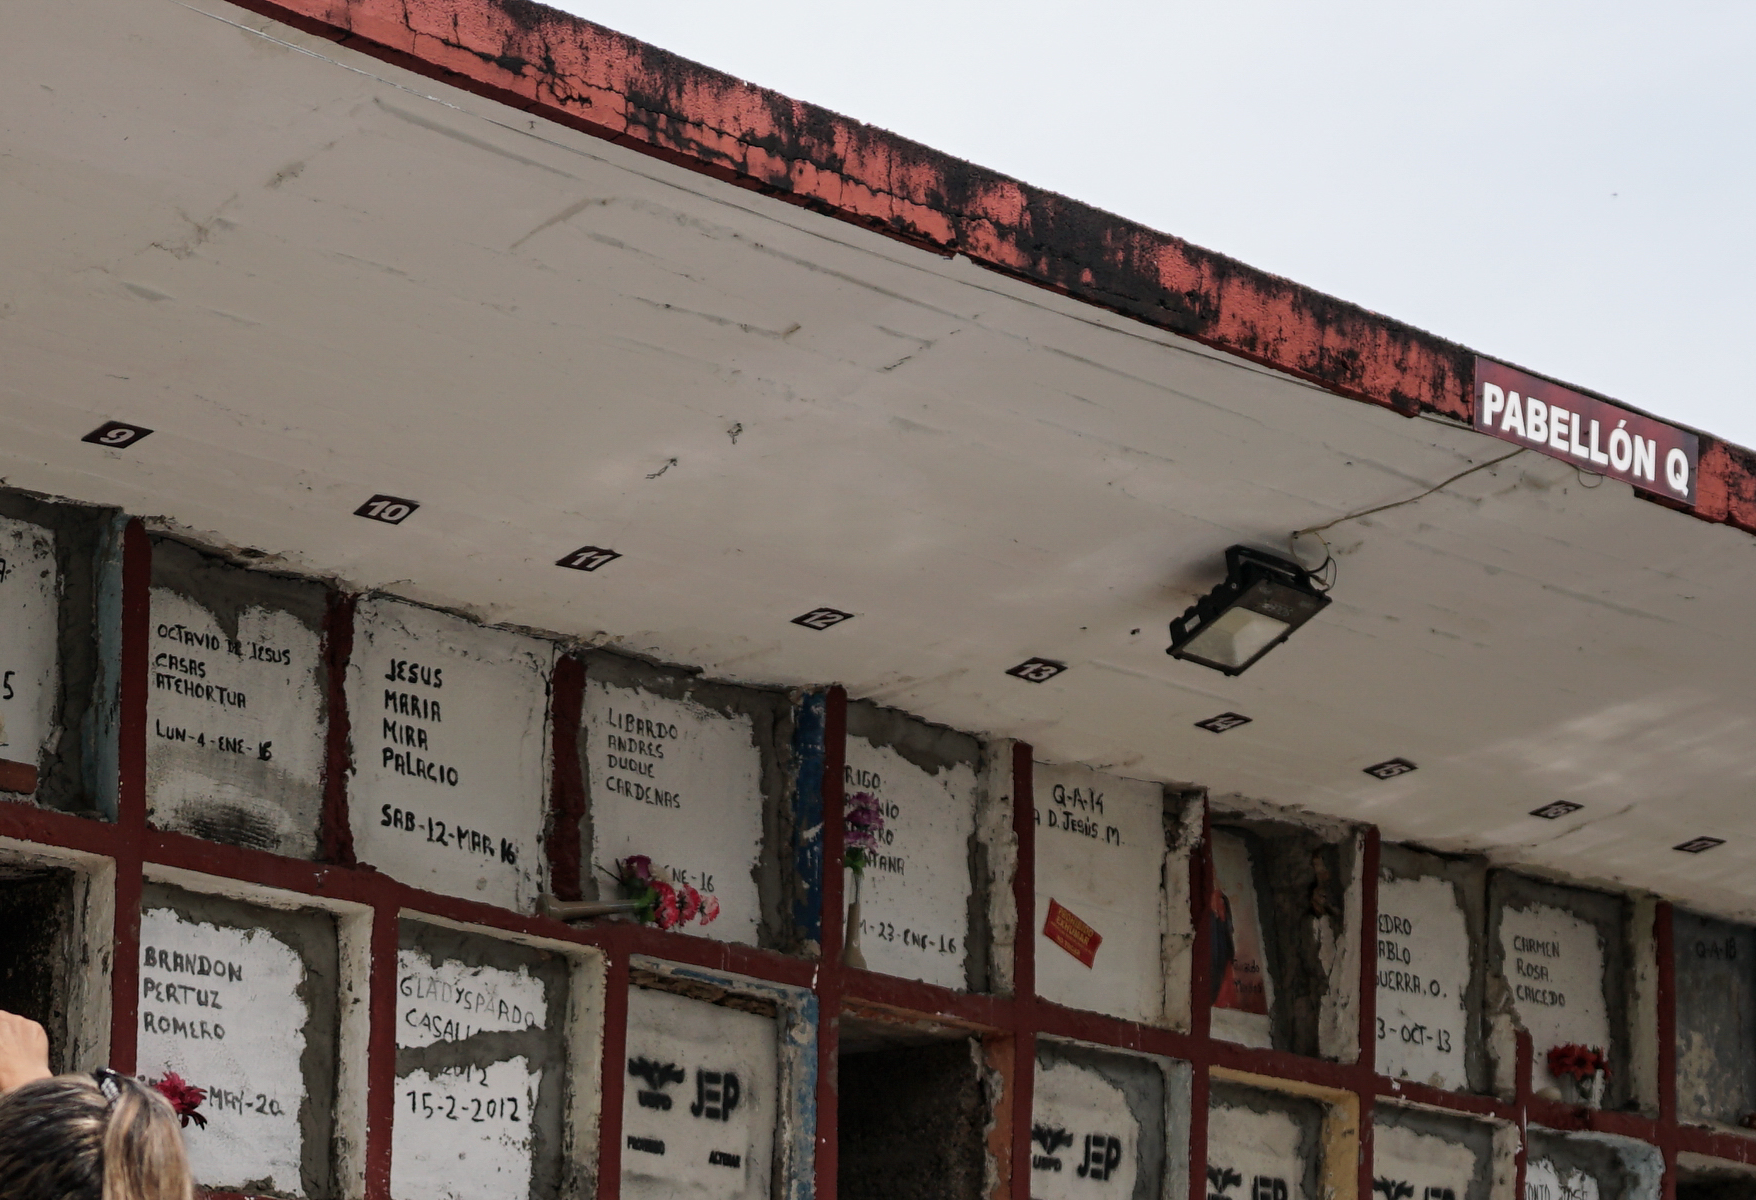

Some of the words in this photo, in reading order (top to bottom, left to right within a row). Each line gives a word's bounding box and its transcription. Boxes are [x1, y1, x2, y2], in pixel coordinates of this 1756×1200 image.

[99, 427, 139, 445] 9
[1482, 381, 1657, 482] PABELLÓN
[1666, 447, 1690, 499] Q
[367, 499, 411, 521] 10
[573, 549, 610, 569] 11
[807, 611, 844, 628] 12
[158, 623, 220, 651] OCTAVIO
[250, 641, 291, 666] JESUS
[155, 653, 206, 678] CASAS
[384, 659, 443, 689] JESUS
[1021, 661, 1057, 679] 13
[156, 672, 247, 709] ATEHORTUA
[384, 689, 442, 723] MARIA
[383, 718, 428, 751] MIRA
[607, 707, 678, 740] LIBARDO
[607, 734, 664, 760] ANDRES
[382, 746, 459, 786] PALACIO
[607, 754, 656, 779] DUQUE
[605, 776, 682, 809] CARDENAS
[144, 945, 243, 982] BRANDON
[144, 977, 223, 1010] PERTUZ
[144, 1010, 226, 1041] ROMERO
[406, 1090, 522, 1122] 15-2-2012
